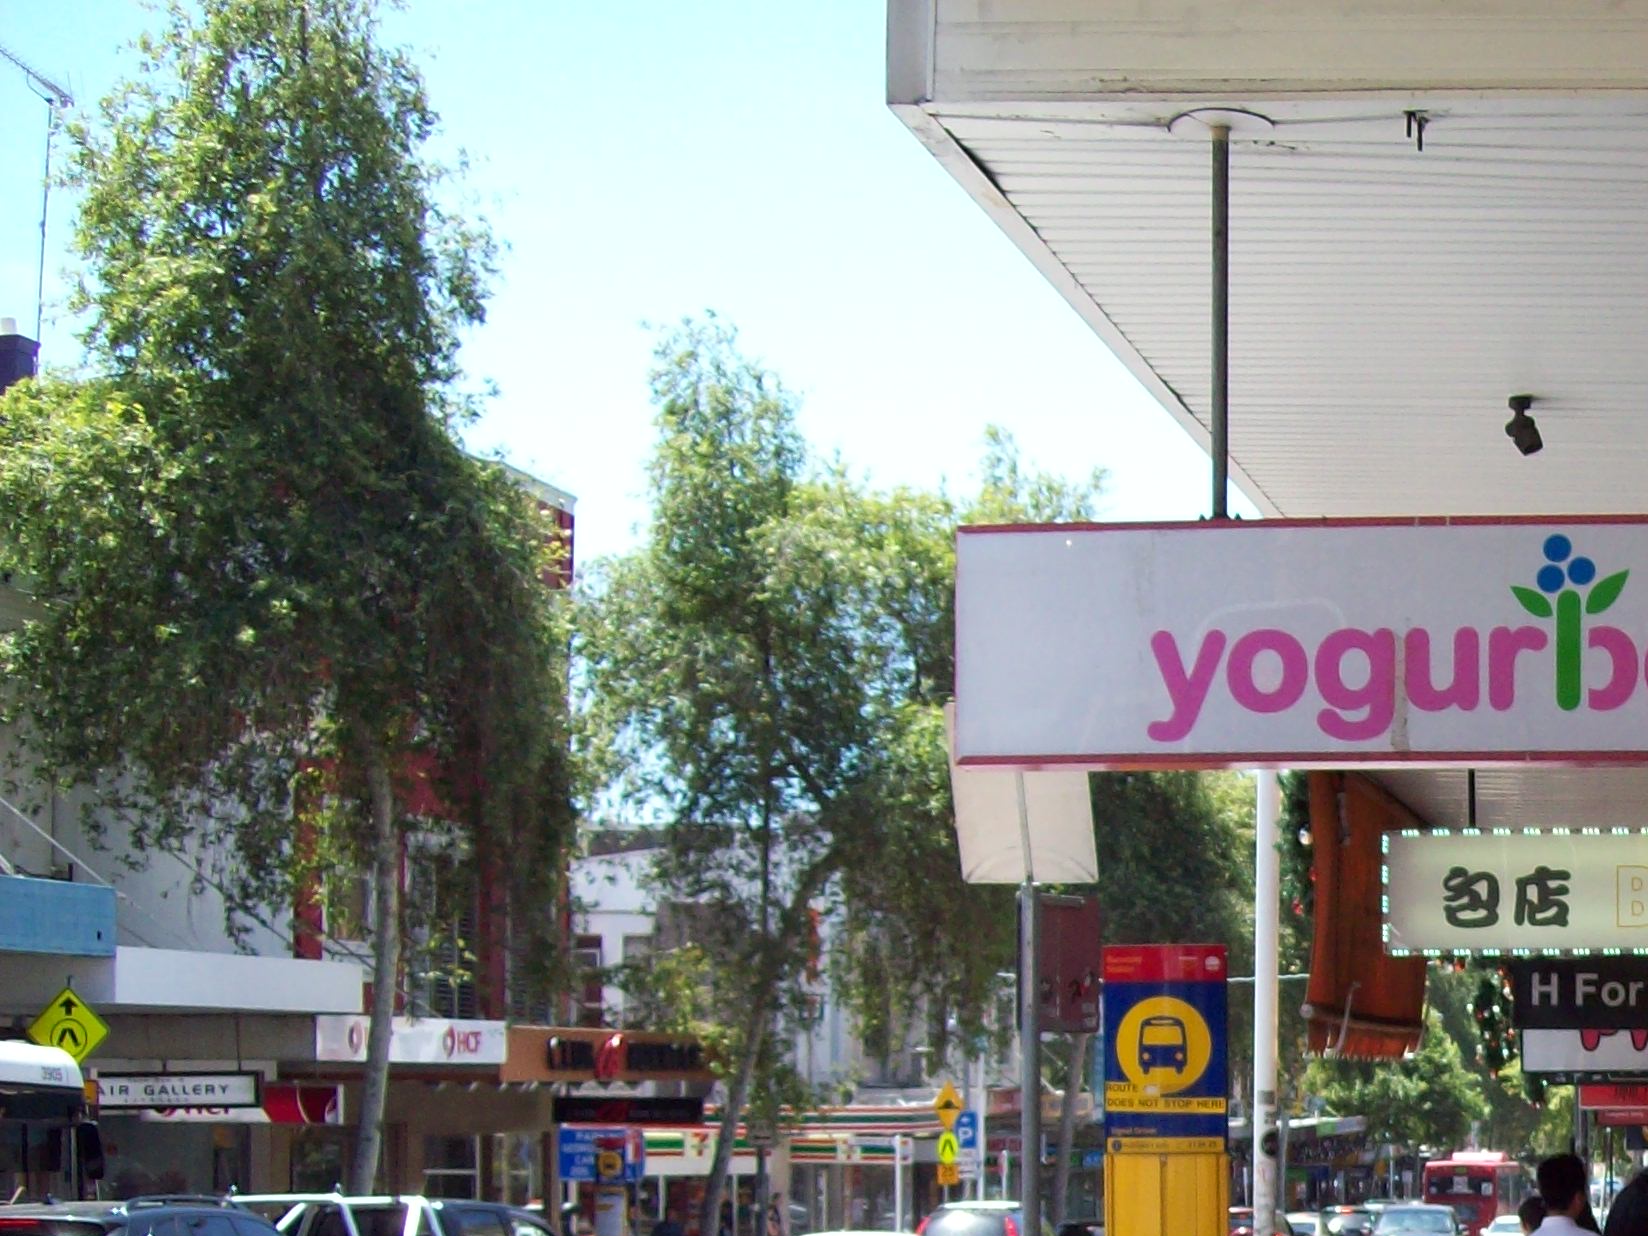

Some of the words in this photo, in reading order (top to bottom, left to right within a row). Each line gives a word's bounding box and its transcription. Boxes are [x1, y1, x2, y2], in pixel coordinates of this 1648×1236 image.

[1530, 972, 1559, 1007] H
[1575, 972, 1645, 1007] For
[457, 1030, 482, 1053] HCF
[144, 1084, 229, 1096] GALLERY
[1107, 1082, 1138, 1093] ROUTE
[1107, 1098, 1134, 1107] DOES
[1139, 1098, 1158, 1107] NOT
[1164, 1098, 1192, 1108] STOP
[1197, 1099, 1225, 1109] HERE
